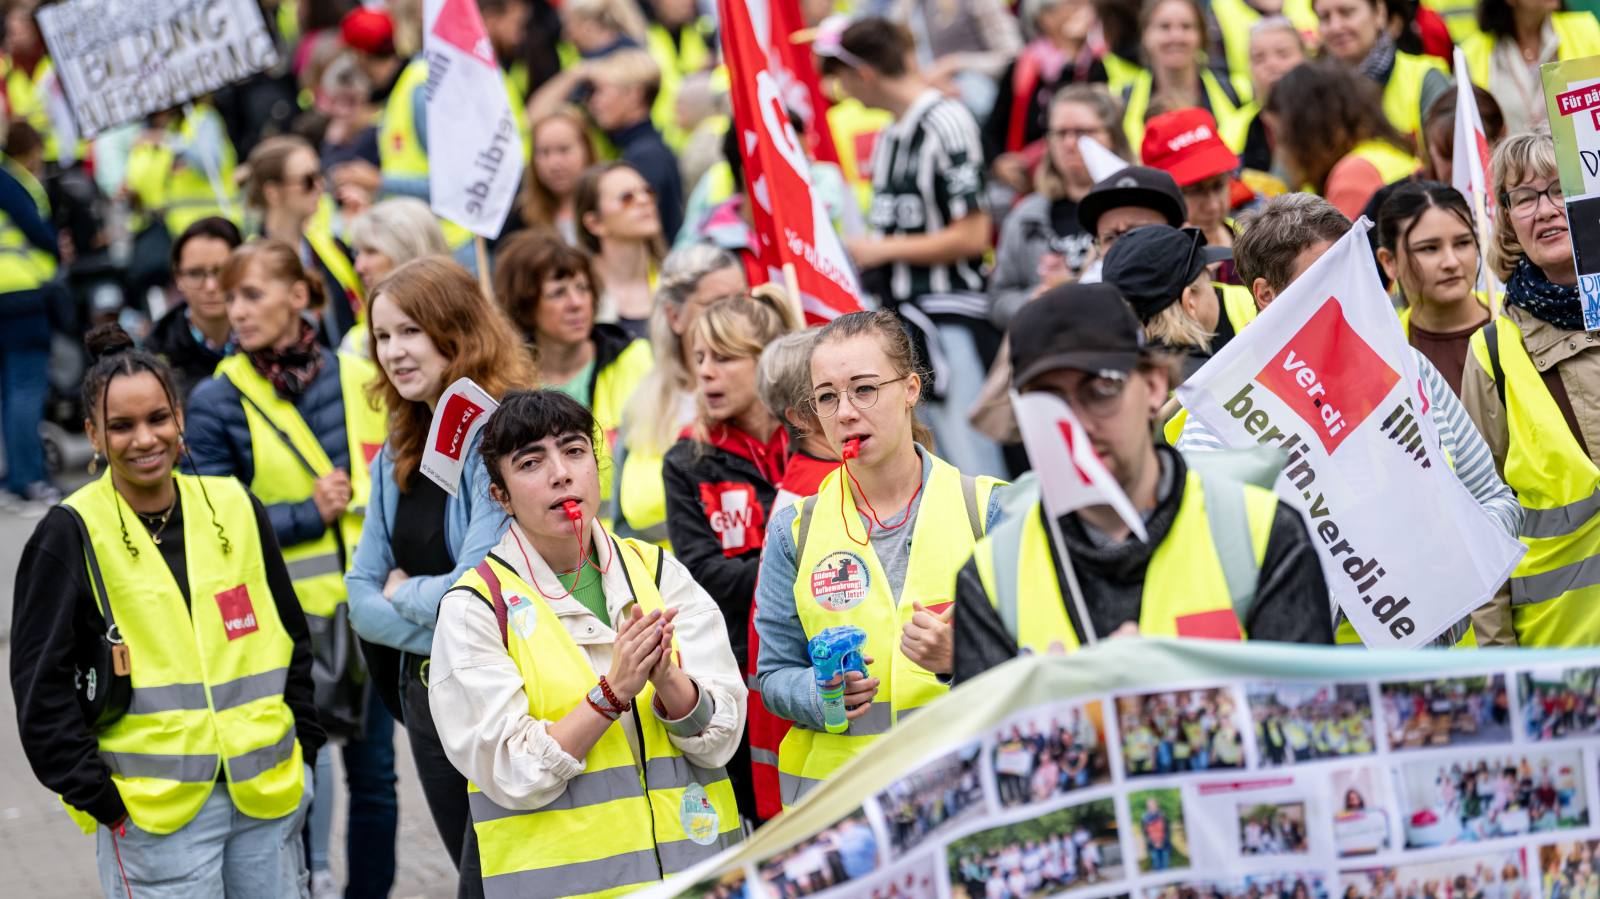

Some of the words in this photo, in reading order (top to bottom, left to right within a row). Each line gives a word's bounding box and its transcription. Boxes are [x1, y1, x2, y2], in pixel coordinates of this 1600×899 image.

[80, 2, 227, 91] BILDUNG
[1561, 95, 1582, 111] Für
[1584, 89, 1600, 106] pä
[1281, 350, 1347, 437] ver.di
[449, 406, 476, 454] ver.di
[710, 505, 753, 532] GEW
[1222, 383, 1415, 641] berlin.verdi.de
[813, 571, 837, 580] Bildung
[815, 582, 861, 595] Aufbewahrung!
[846, 590, 865, 599] Jetzt!
[225, 613, 256, 631] ver.di
